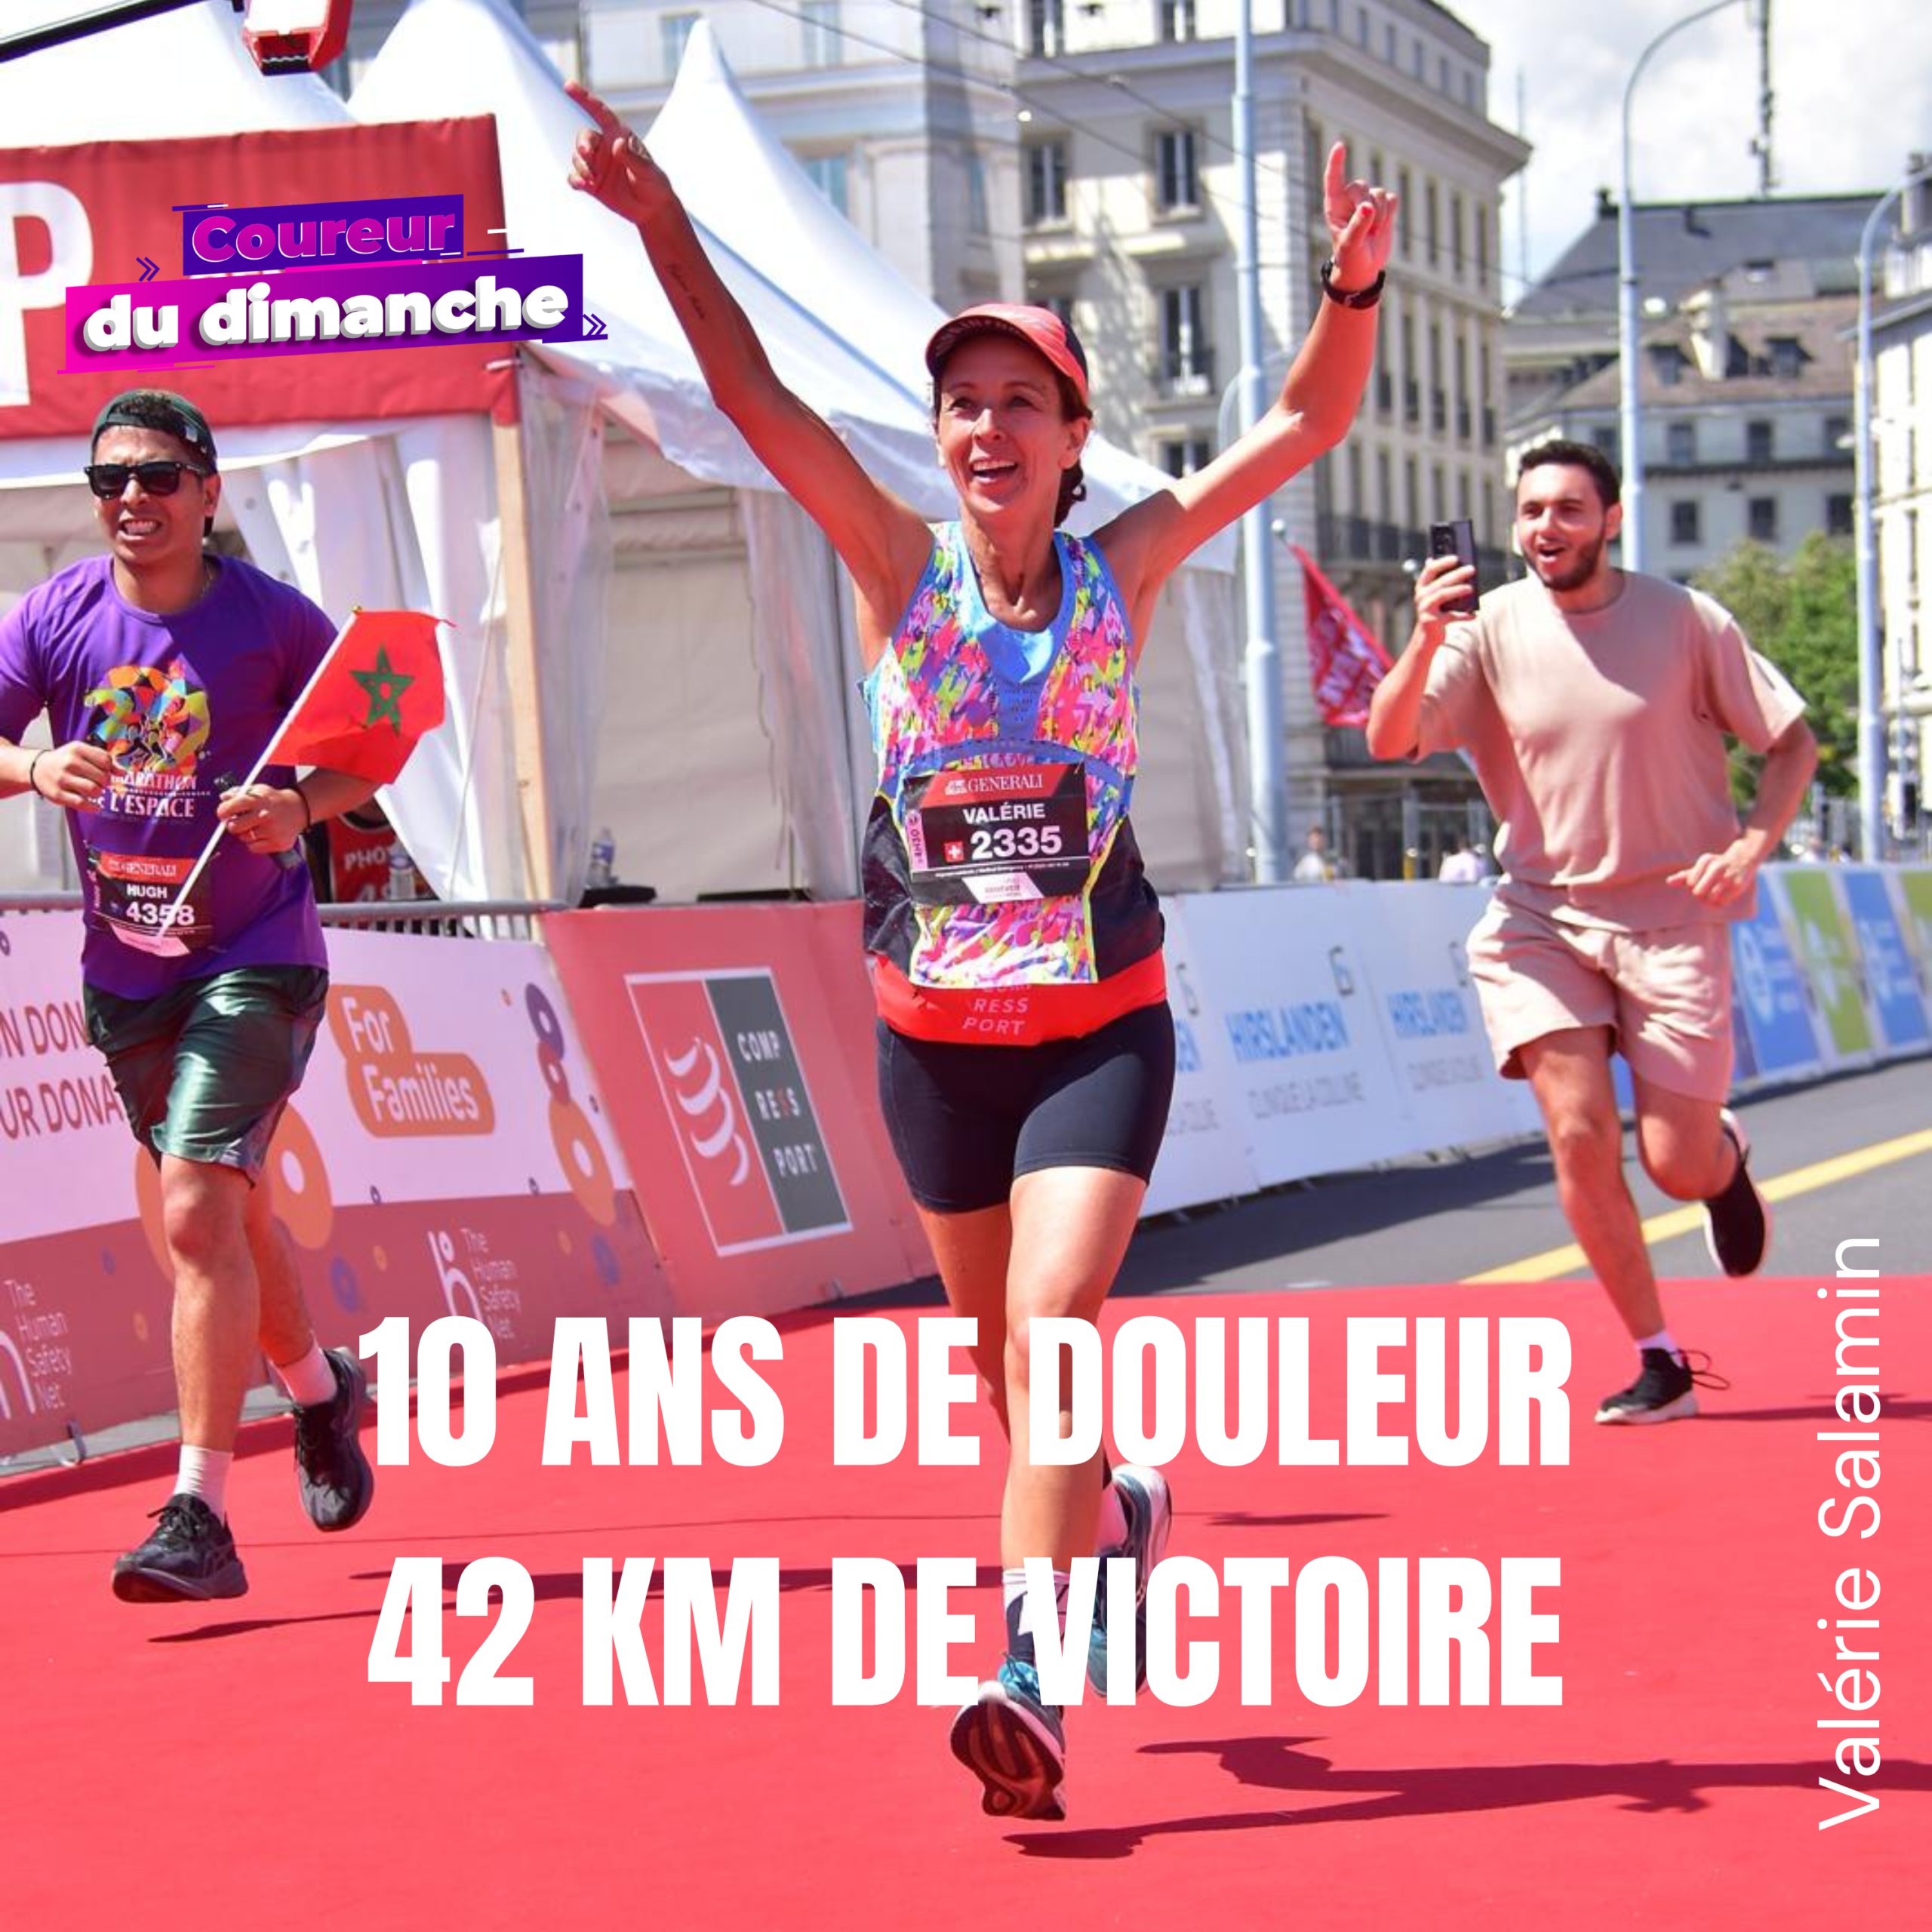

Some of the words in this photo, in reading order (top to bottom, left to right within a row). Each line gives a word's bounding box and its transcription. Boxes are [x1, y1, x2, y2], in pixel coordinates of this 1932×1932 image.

[967, 773, 1044, 792] GENERALI
[109, 793, 195, 817] L'ESPACE
[963, 801, 1046, 825] VALÉRIE
[970, 825, 1063, 861] 2335
[126, 883, 168, 899] HUGH
[973, 997, 1029, 1013] RESS
[341, 995, 395, 1054] For
[961, 1017, 1026, 1036] PORT
[737, 1030, 780, 1063] COMP
[361, 1062, 480, 1122] Families
[773, 1143, 819, 1178] PORT
